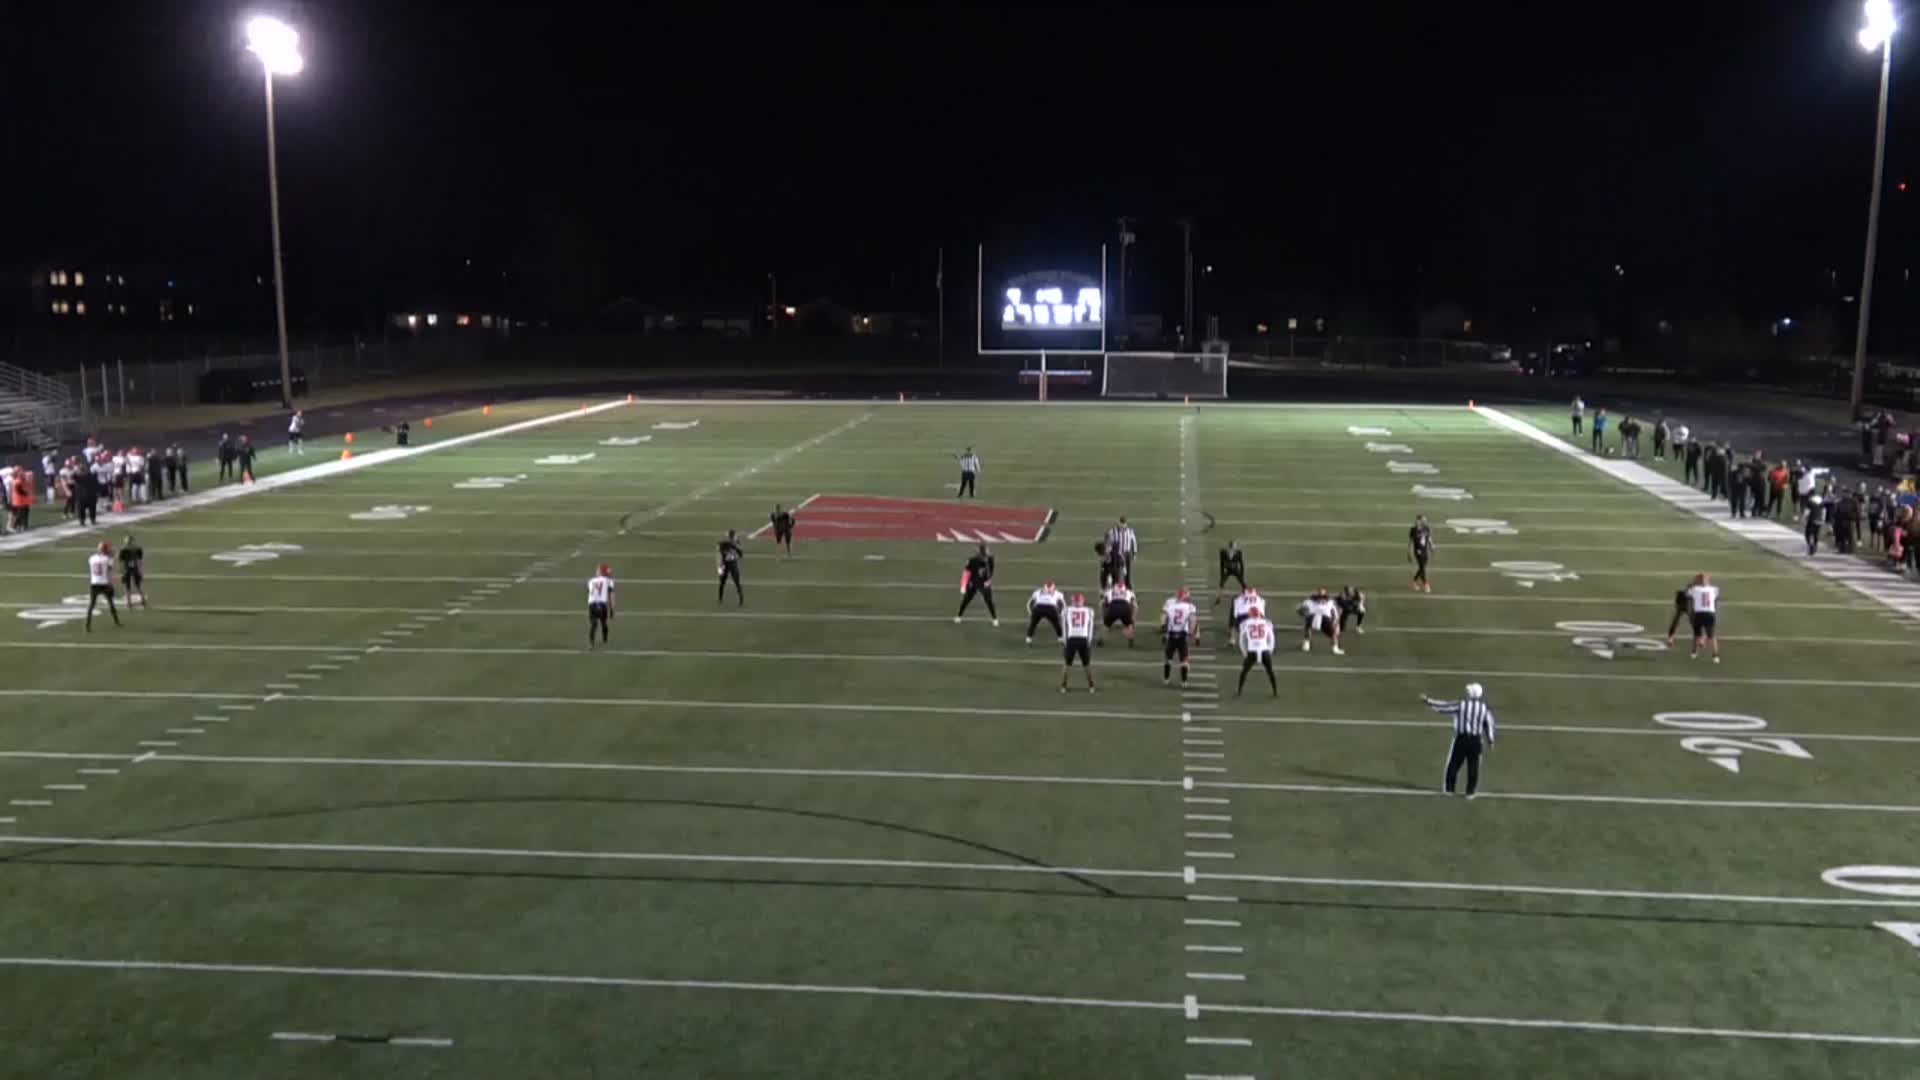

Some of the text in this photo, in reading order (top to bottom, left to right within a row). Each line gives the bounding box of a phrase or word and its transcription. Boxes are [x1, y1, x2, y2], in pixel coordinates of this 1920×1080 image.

[1071, 610, 1087, 629] 21
[1173, 608, 1184, 626] 2
[1247, 623, 1266, 641] 26
[1652, 711, 1814, 760] 20
